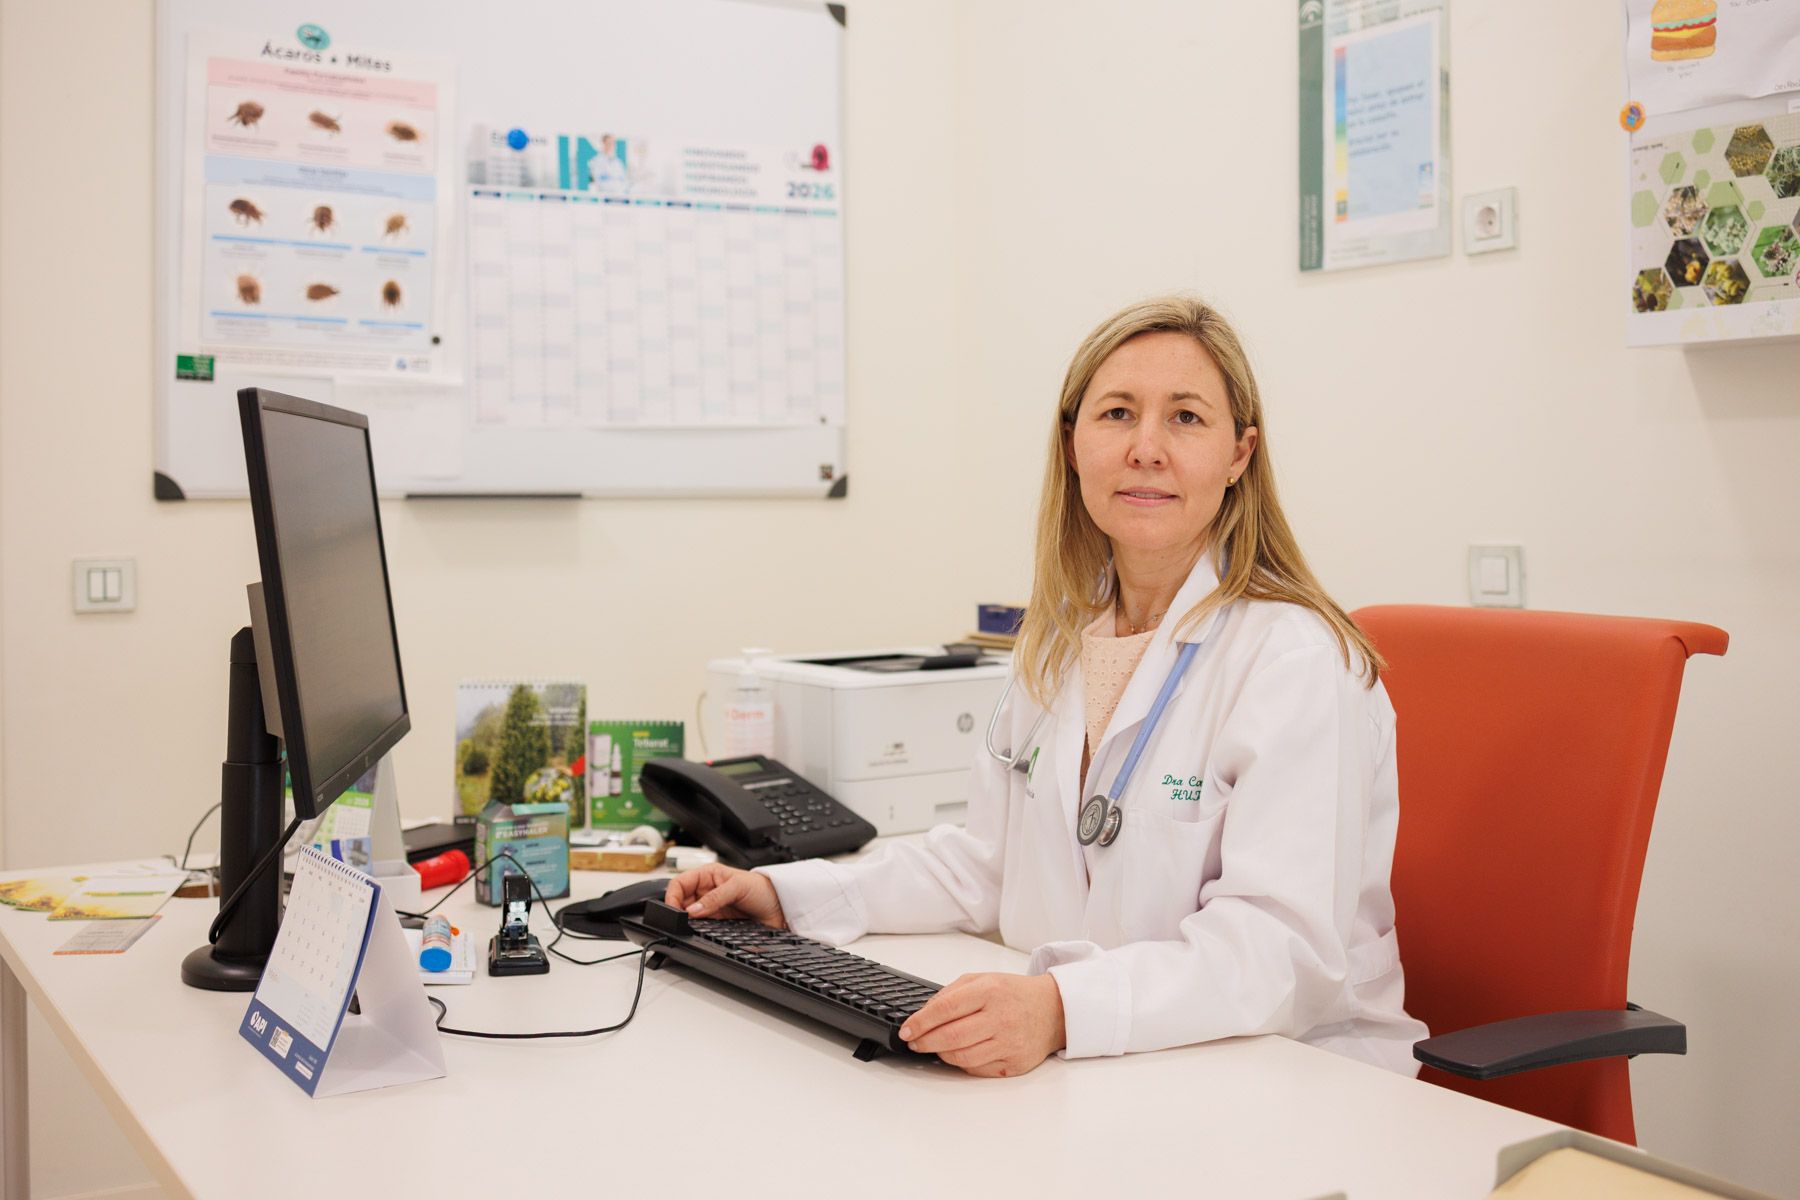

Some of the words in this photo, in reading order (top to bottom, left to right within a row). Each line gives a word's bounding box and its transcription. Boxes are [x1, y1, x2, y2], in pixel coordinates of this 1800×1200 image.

[261, 41, 321, 63] Ácaros
[346, 54, 391, 72] Mites
[787, 181, 835, 200] 2026
[1162, 774, 1183, 785] Dra
